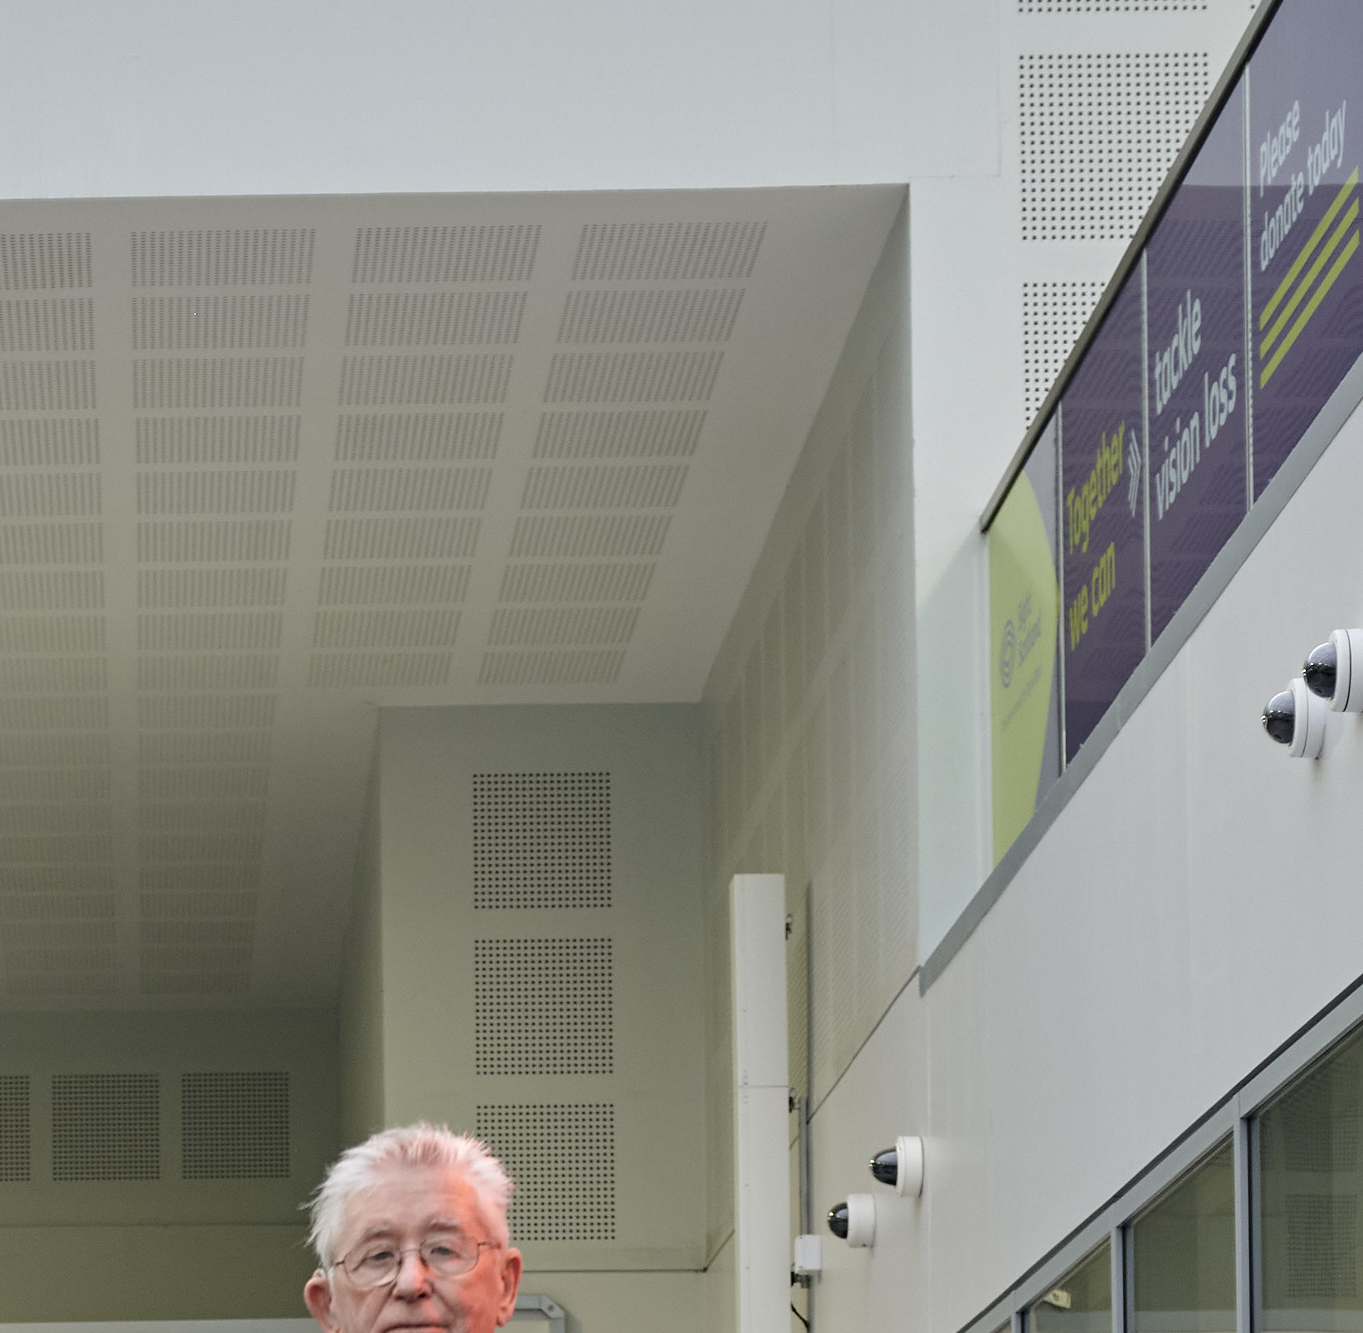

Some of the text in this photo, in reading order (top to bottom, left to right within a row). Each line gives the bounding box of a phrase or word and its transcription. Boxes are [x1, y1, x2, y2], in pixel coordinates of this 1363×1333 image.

[1260, 100, 1300, 198] Please
[1260, 100, 1346, 272] donate today
[1155, 289, 1201, 416] tackle
[1067, 419, 1125, 555] Together
[1155, 353, 1236, 521] vision loss
[1069, 542, 1116, 650] we can
